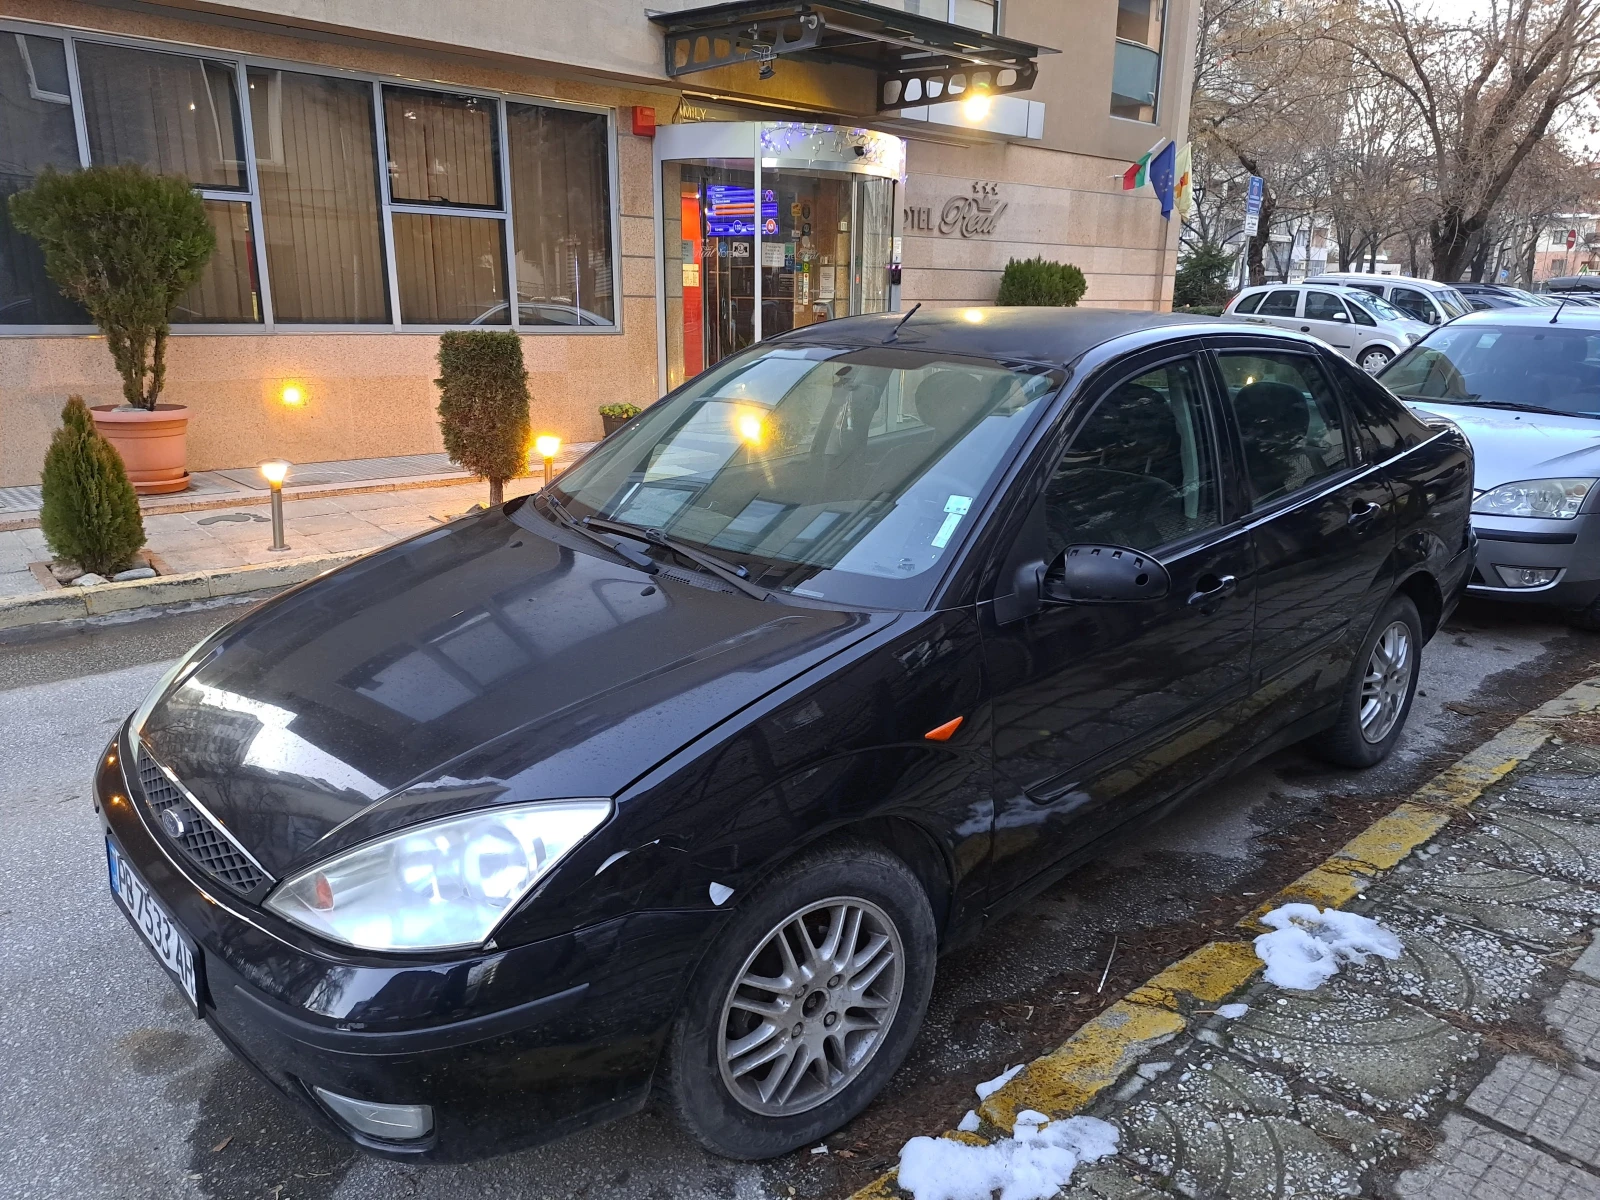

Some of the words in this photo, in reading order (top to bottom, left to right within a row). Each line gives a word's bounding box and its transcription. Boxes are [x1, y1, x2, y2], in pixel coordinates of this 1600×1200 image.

[680, 106, 707, 120] MILY
[903, 206, 934, 231] OTEL
[938, 195, 1009, 238] Real
[118, 857, 135, 911] PB
[135, 880, 171, 960] 7533
[175, 934, 196, 995] AH
